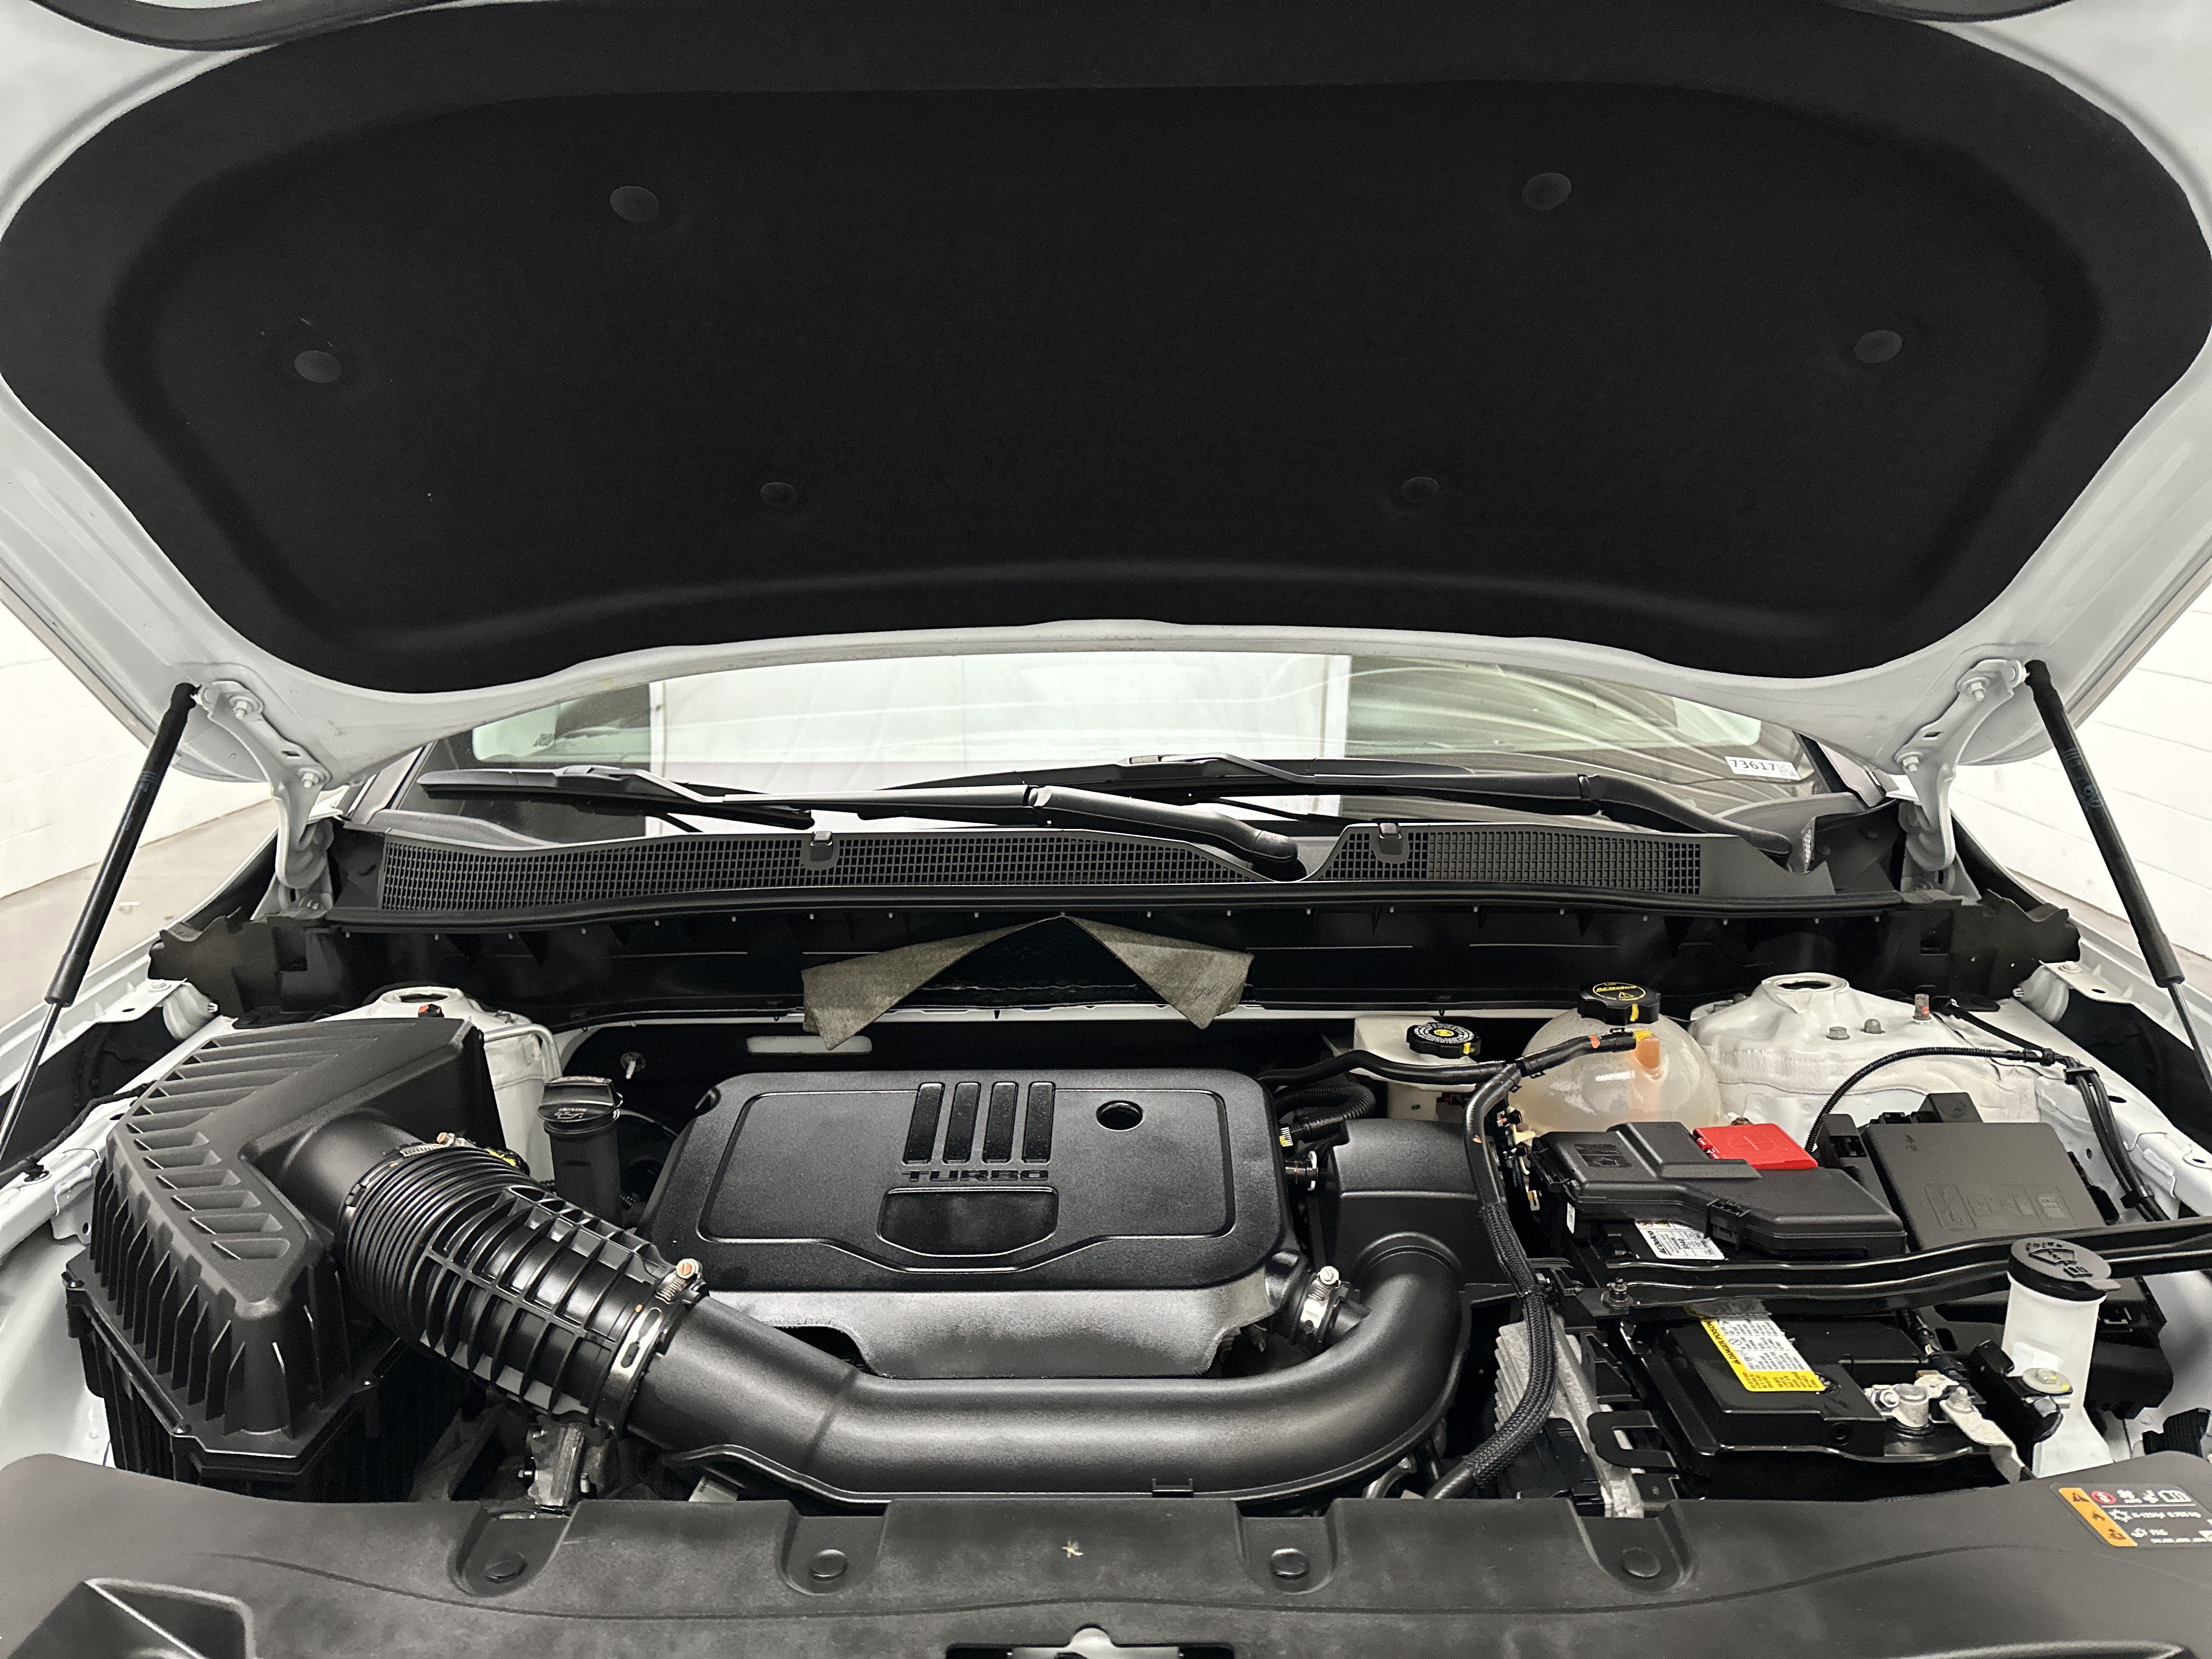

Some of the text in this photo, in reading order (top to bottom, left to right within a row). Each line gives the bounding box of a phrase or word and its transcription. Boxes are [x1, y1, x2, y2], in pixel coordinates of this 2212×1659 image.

[1729, 759, 1775, 771] 73617
[902, 1170, 1049, 1181] TURBO
[1647, 1231, 1668, 1255] ACDelco
